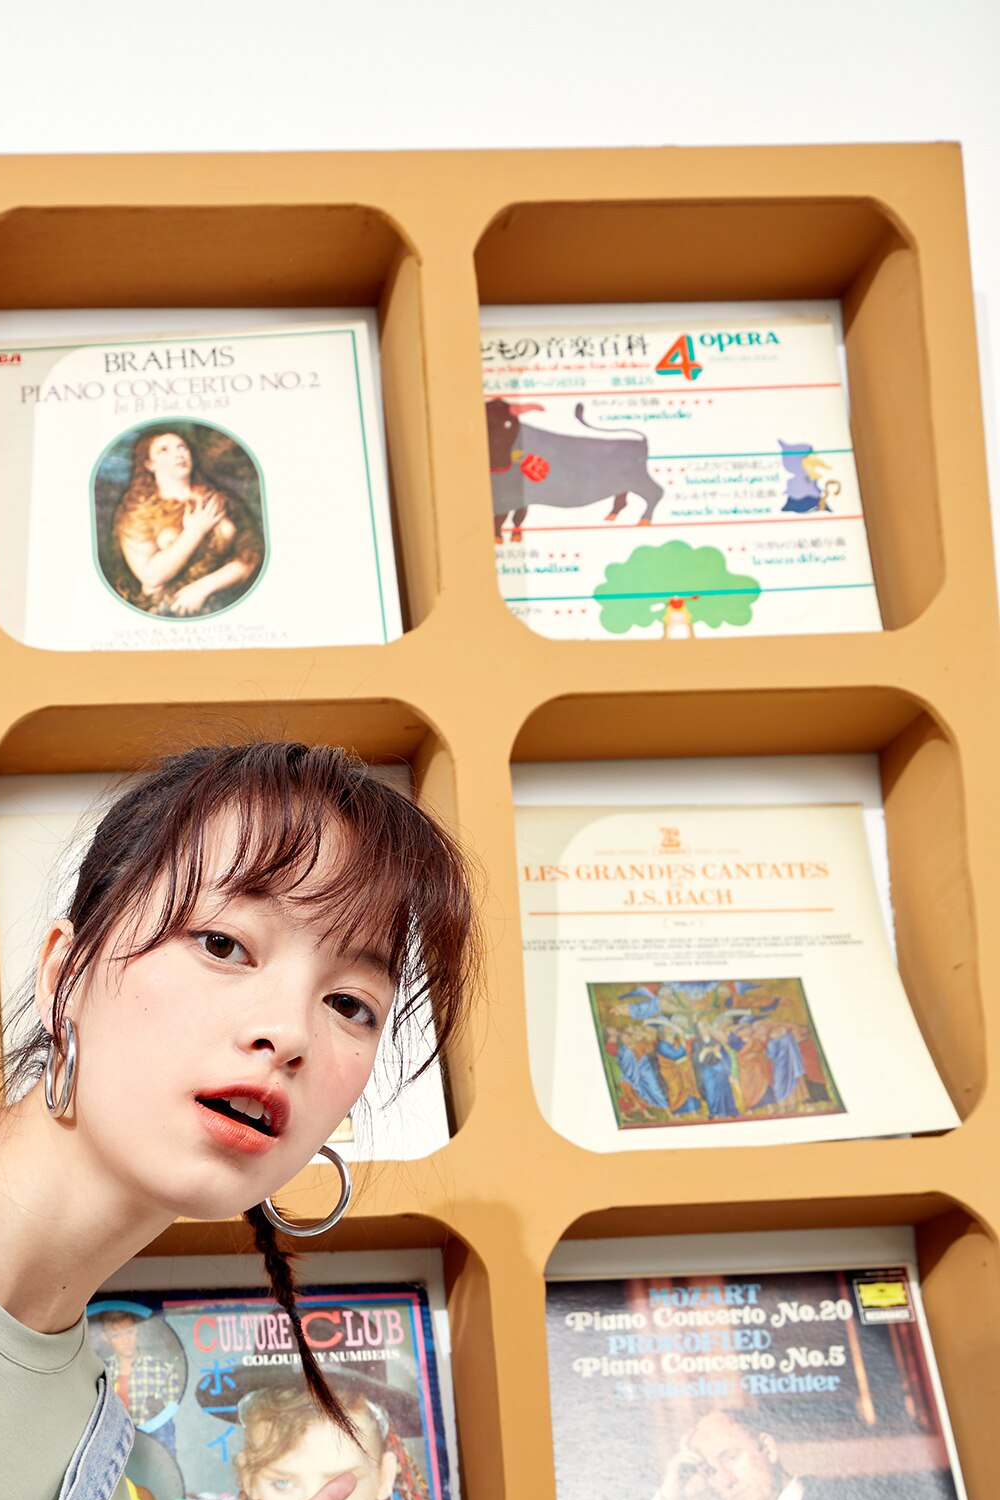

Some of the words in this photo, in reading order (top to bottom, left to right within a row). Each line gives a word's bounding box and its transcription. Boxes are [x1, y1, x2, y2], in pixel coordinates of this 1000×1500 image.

[103, 345, 236, 373] BRAHMS
[655, 334, 703, 381] 4
[20, 380, 105, 403] PIANO
[113, 374, 253, 398] CONCERTO
[523, 864, 570, 883] LES
[575, 862, 697, 882] GRANDES
[702, 861, 830, 880] CANTATES
[648, 1283, 762, 1308] MOZART
[564, 1310, 648, 1333] Piano
[653, 1306, 766, 1329] Concerto
[770, 1299, 854, 1329] No.20
[193, 1313, 293, 1353] CULTURE
[300, 1308, 405, 1349] CLUB
[329, 1349, 400, 1364] NUMBERS
[572, 1356, 655, 1379] Piano
[660, 1350, 777, 1375] Concerto
[779, 1345, 846, 1374] No.5
[740, 1372, 842, 1396] Richter
